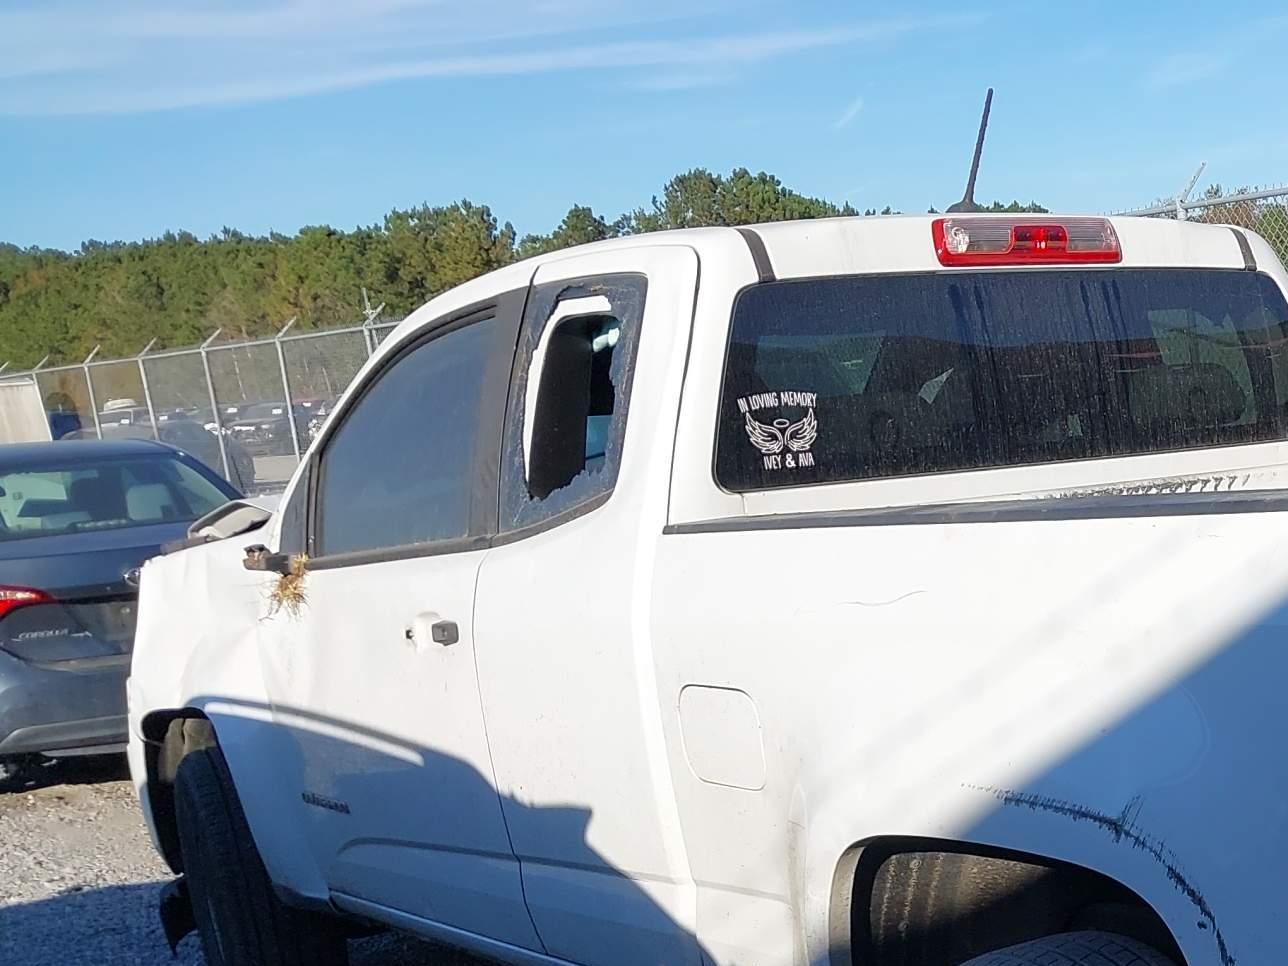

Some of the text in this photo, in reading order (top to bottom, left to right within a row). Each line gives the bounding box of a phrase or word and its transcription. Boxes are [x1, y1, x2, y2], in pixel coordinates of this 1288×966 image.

[737, 391, 817, 413] IN LOVING MEMORY
[763, 452, 815, 470] IVEY & AVA
